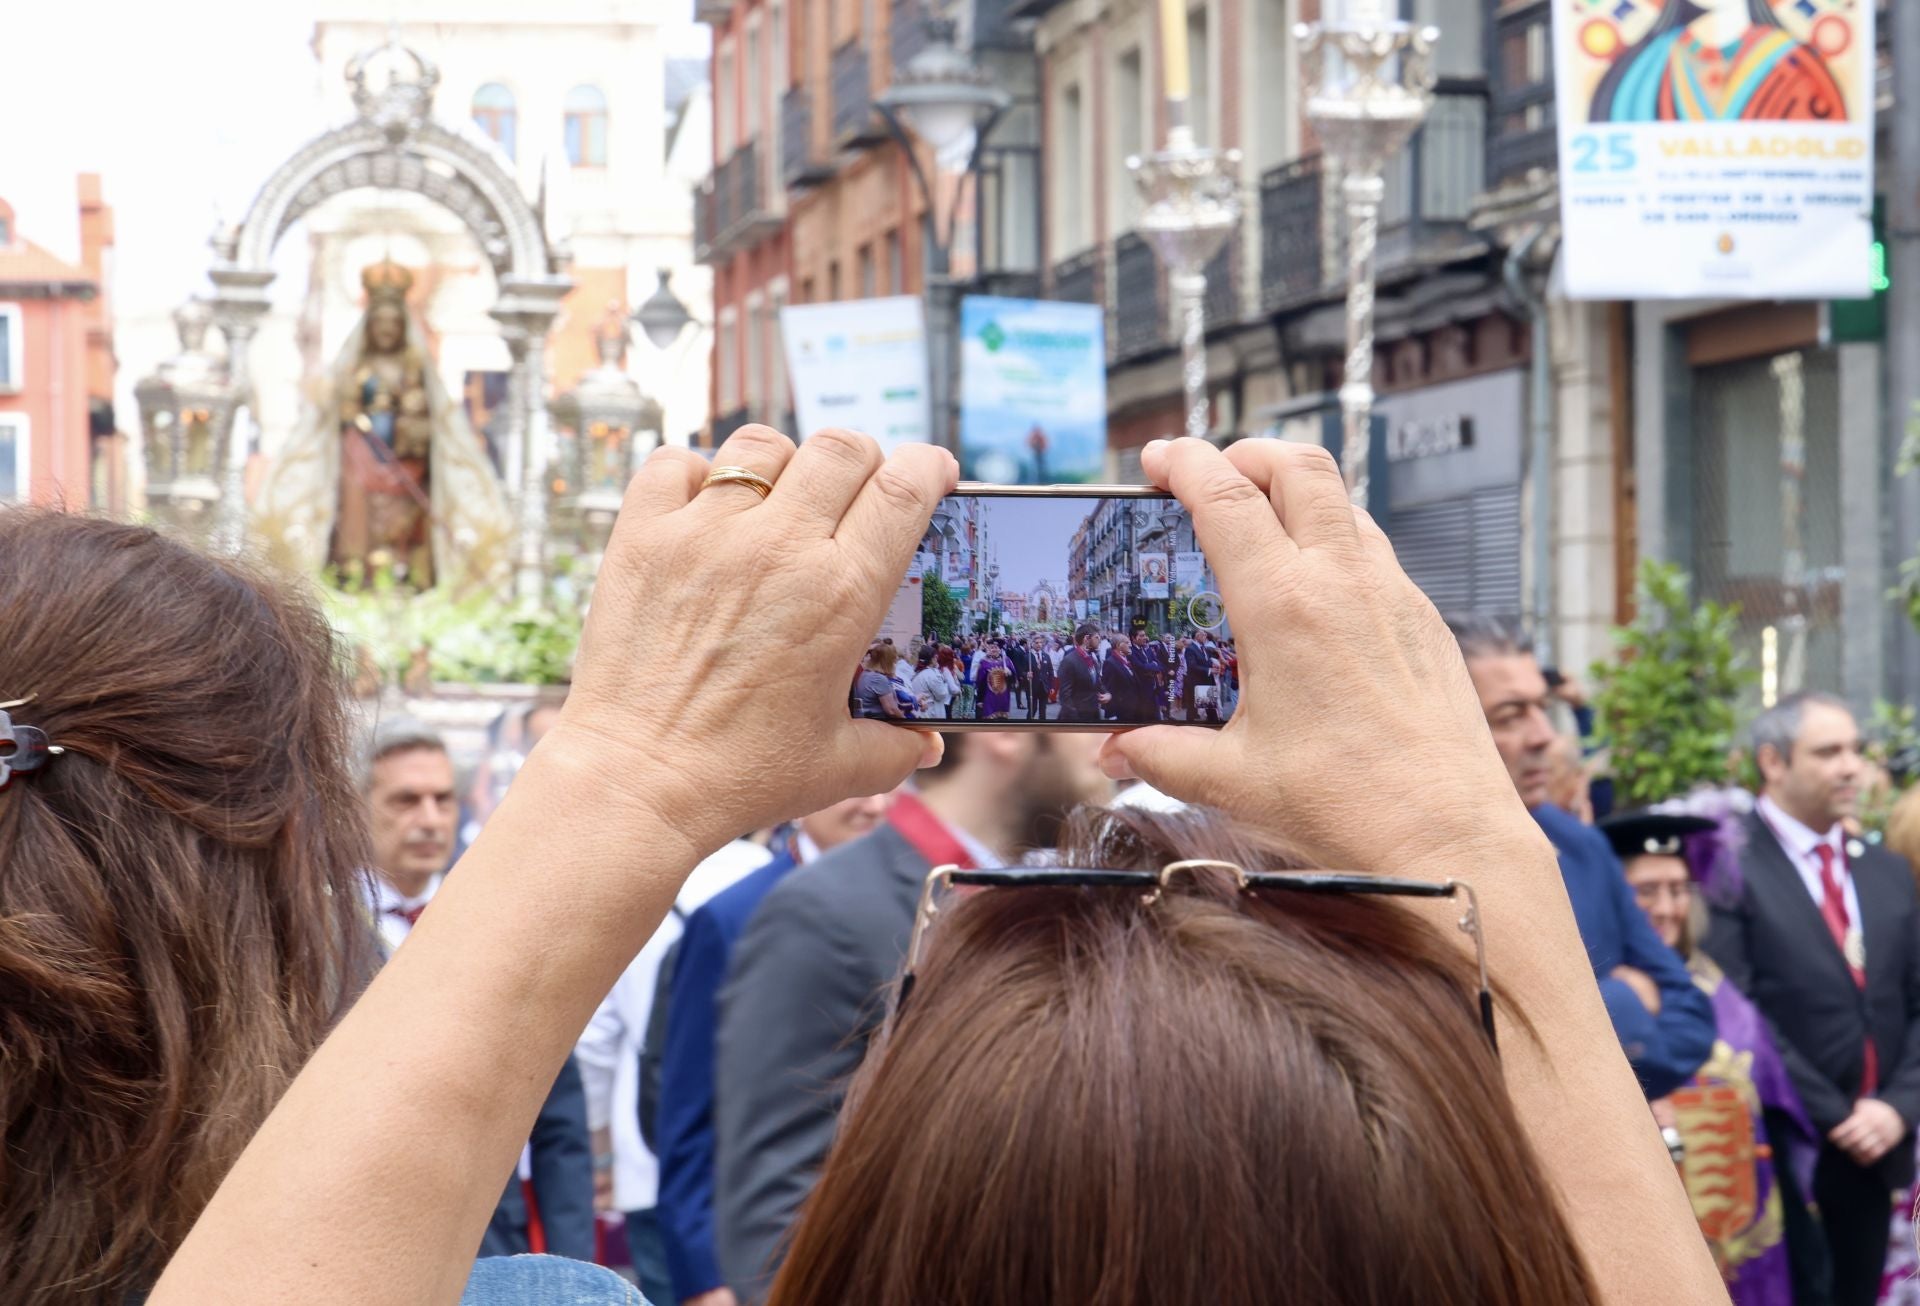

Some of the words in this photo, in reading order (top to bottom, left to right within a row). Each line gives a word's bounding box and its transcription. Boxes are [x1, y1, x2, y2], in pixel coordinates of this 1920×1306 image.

[1570, 132, 1638, 173] 25
[1657, 136, 1867, 161] VALLADOLID
[1169, 530, 1177, 546] Más
[1168, 600, 1176, 619] Foto
[1167, 635, 1176, 663] Retrato
[1167, 679, 1176, 702] Noche
